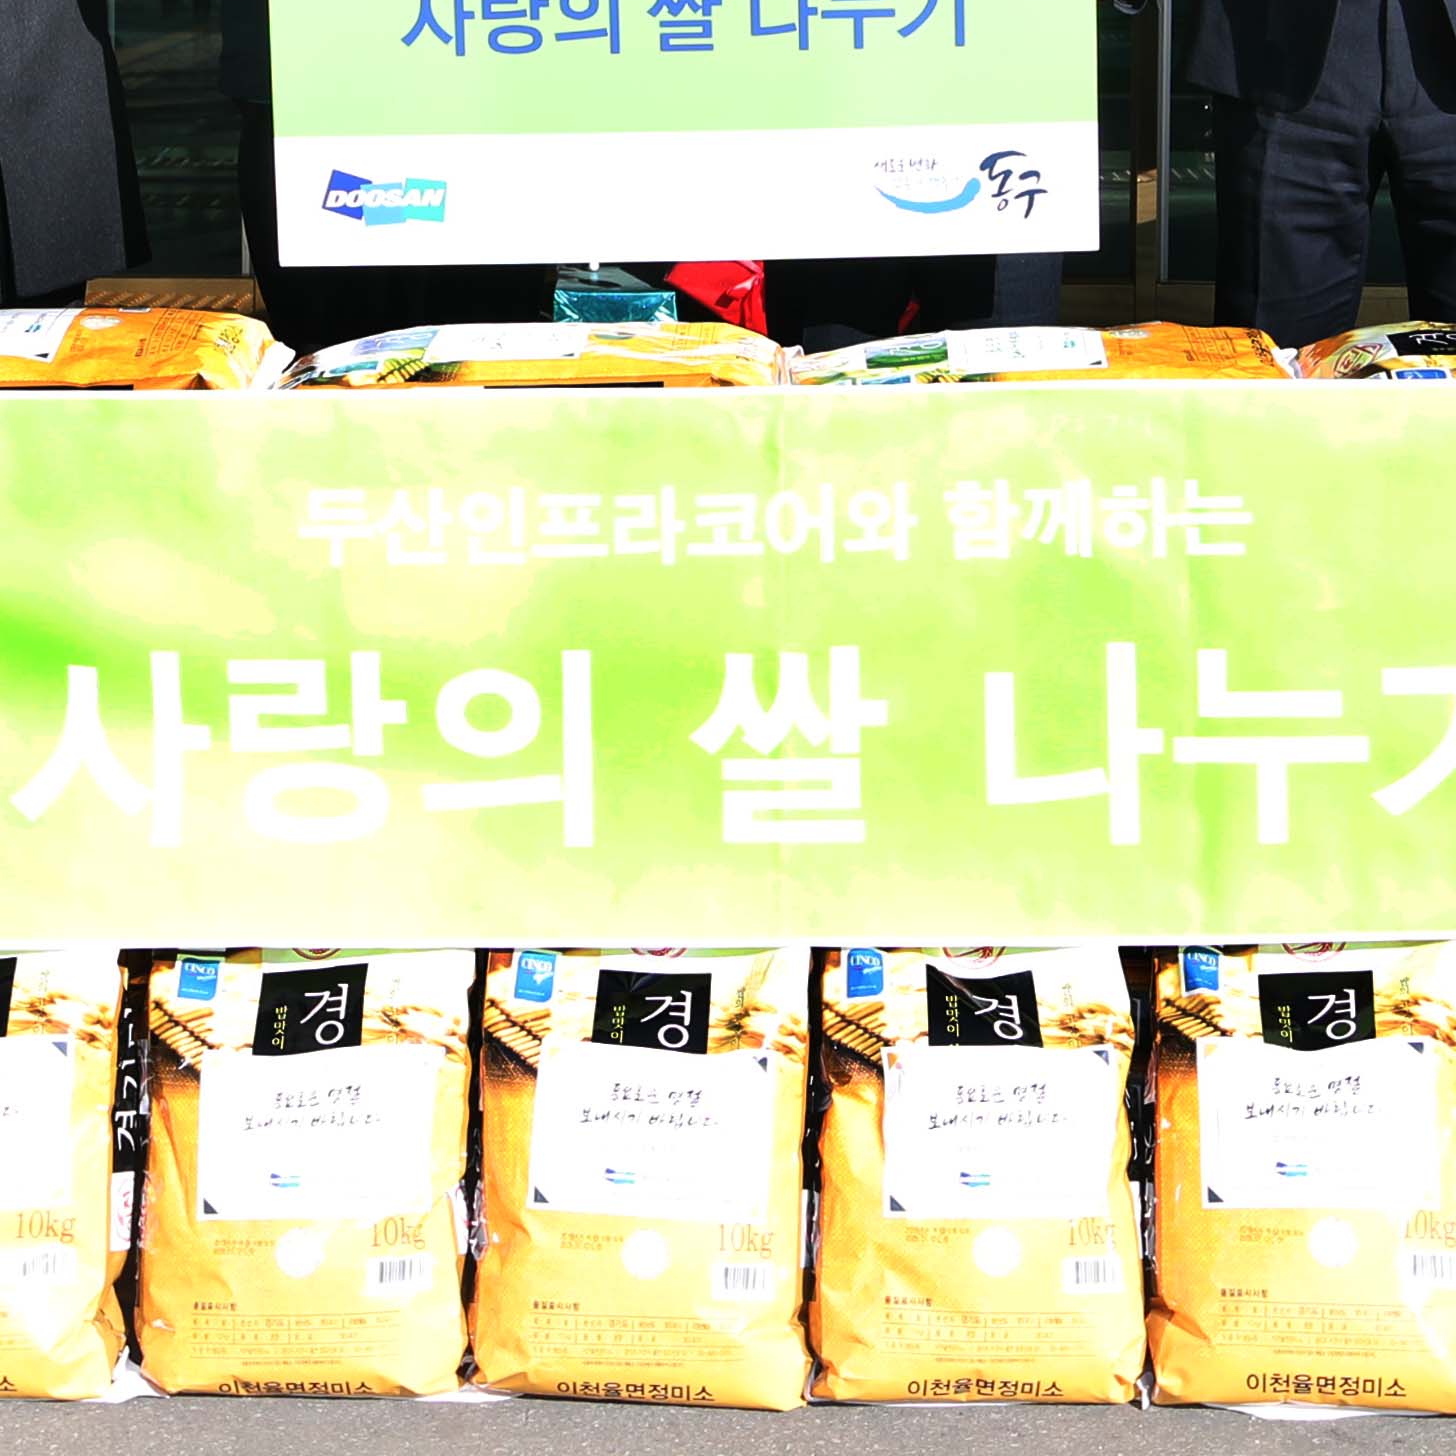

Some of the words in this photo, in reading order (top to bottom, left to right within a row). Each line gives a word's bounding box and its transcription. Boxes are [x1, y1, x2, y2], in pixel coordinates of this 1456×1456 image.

[325, 187, 444, 210] DOOSAN
[978, 149, 1049, 220] 동구
[298, 480, 919, 566] 두산인프라코어와
[942, 475, 1255, 561] 함께하는
[10, 648, 596, 849] 사랑의
[689, 643, 888, 845] 쌀
[272, 1005, 287, 1050] 밥맛이
[300, 983, 350, 1046] 경
[640, 990, 692, 1049] 경
[945, 994, 961, 1038] 밥맛이
[973, 994, 1024, 1041] 경
[1308, 988, 1358, 1041] 경
[16, 1211, 76, 1243] 10kg
[719, 1223, 775, 1257] 10kg
[557, 1381, 715, 1402] 이천율면정미소
[907, 1379, 1064, 1397] 이천율면정미소
[1247, 1373, 1406, 1397] 이천율면정미소
